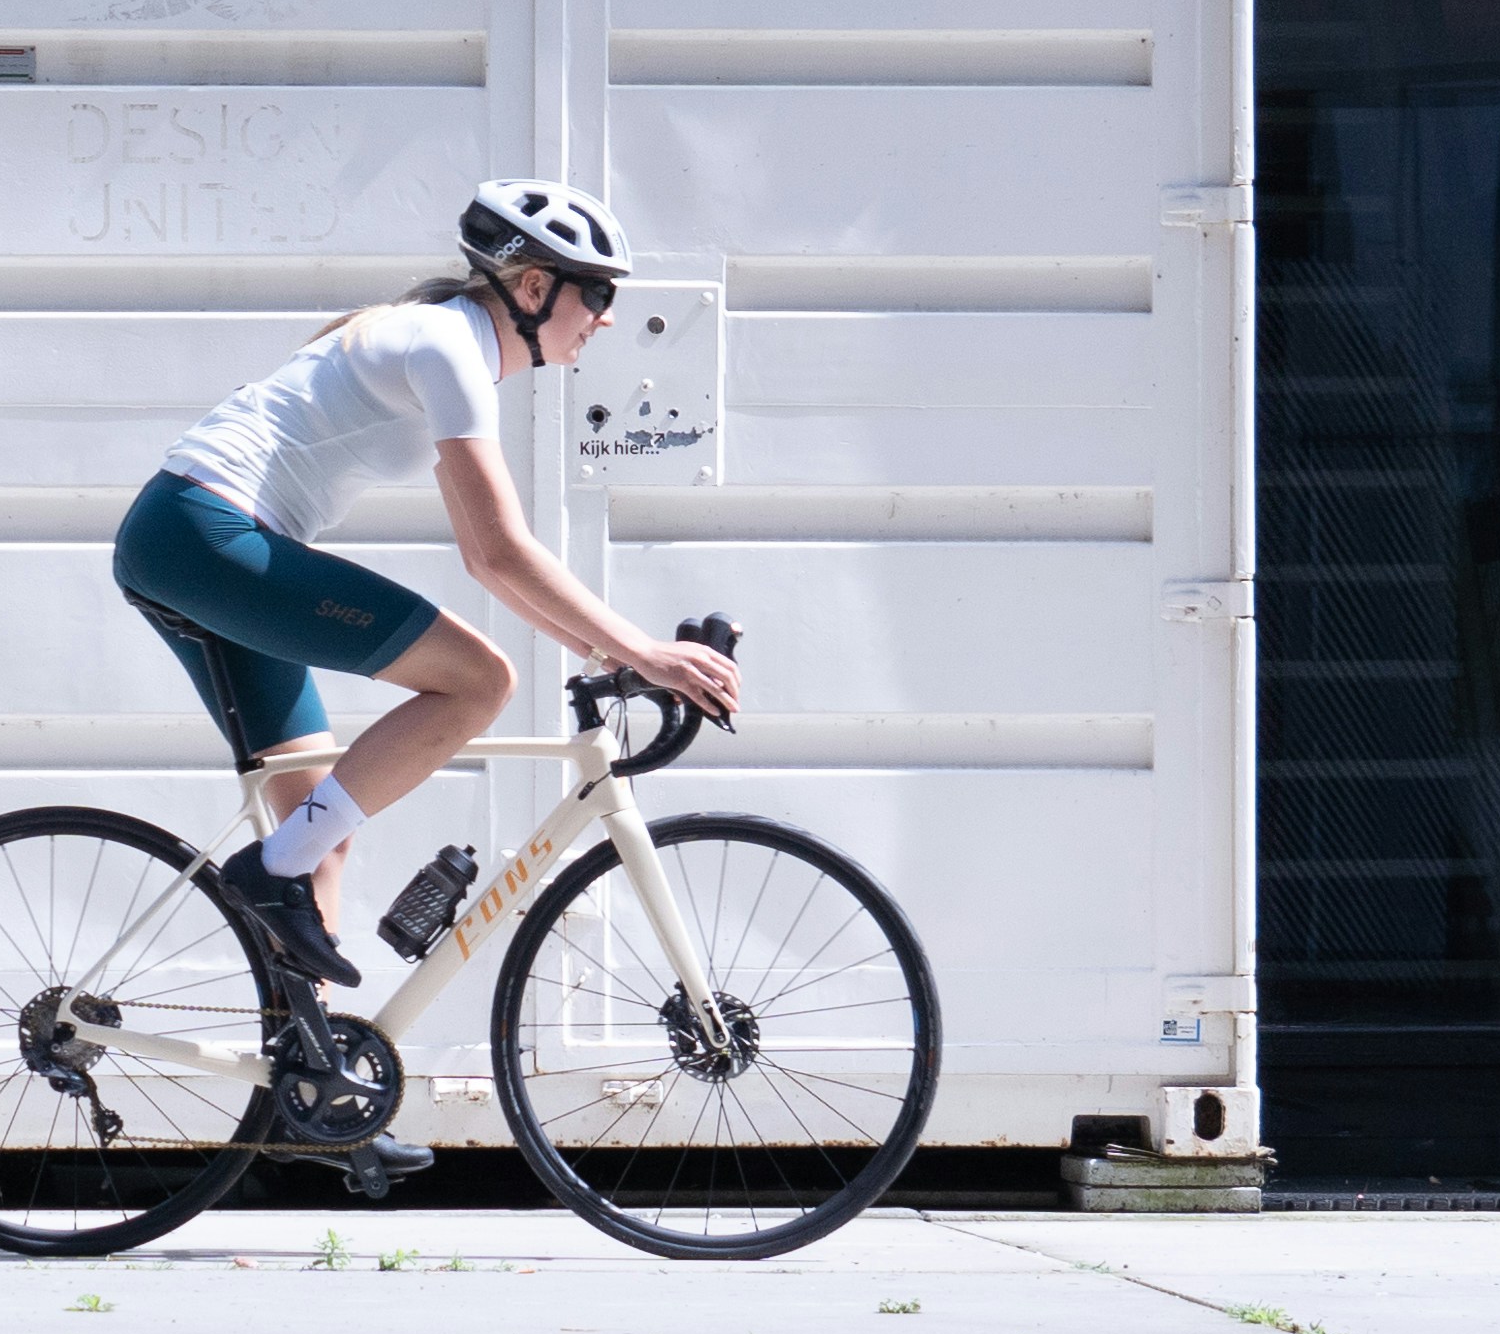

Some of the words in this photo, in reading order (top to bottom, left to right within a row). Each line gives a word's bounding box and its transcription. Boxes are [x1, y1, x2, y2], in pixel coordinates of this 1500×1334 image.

[67, 104, 341, 164] DESIGN
[579, 440, 610, 459] Kijk
[614, 439, 660, 455] hier...
